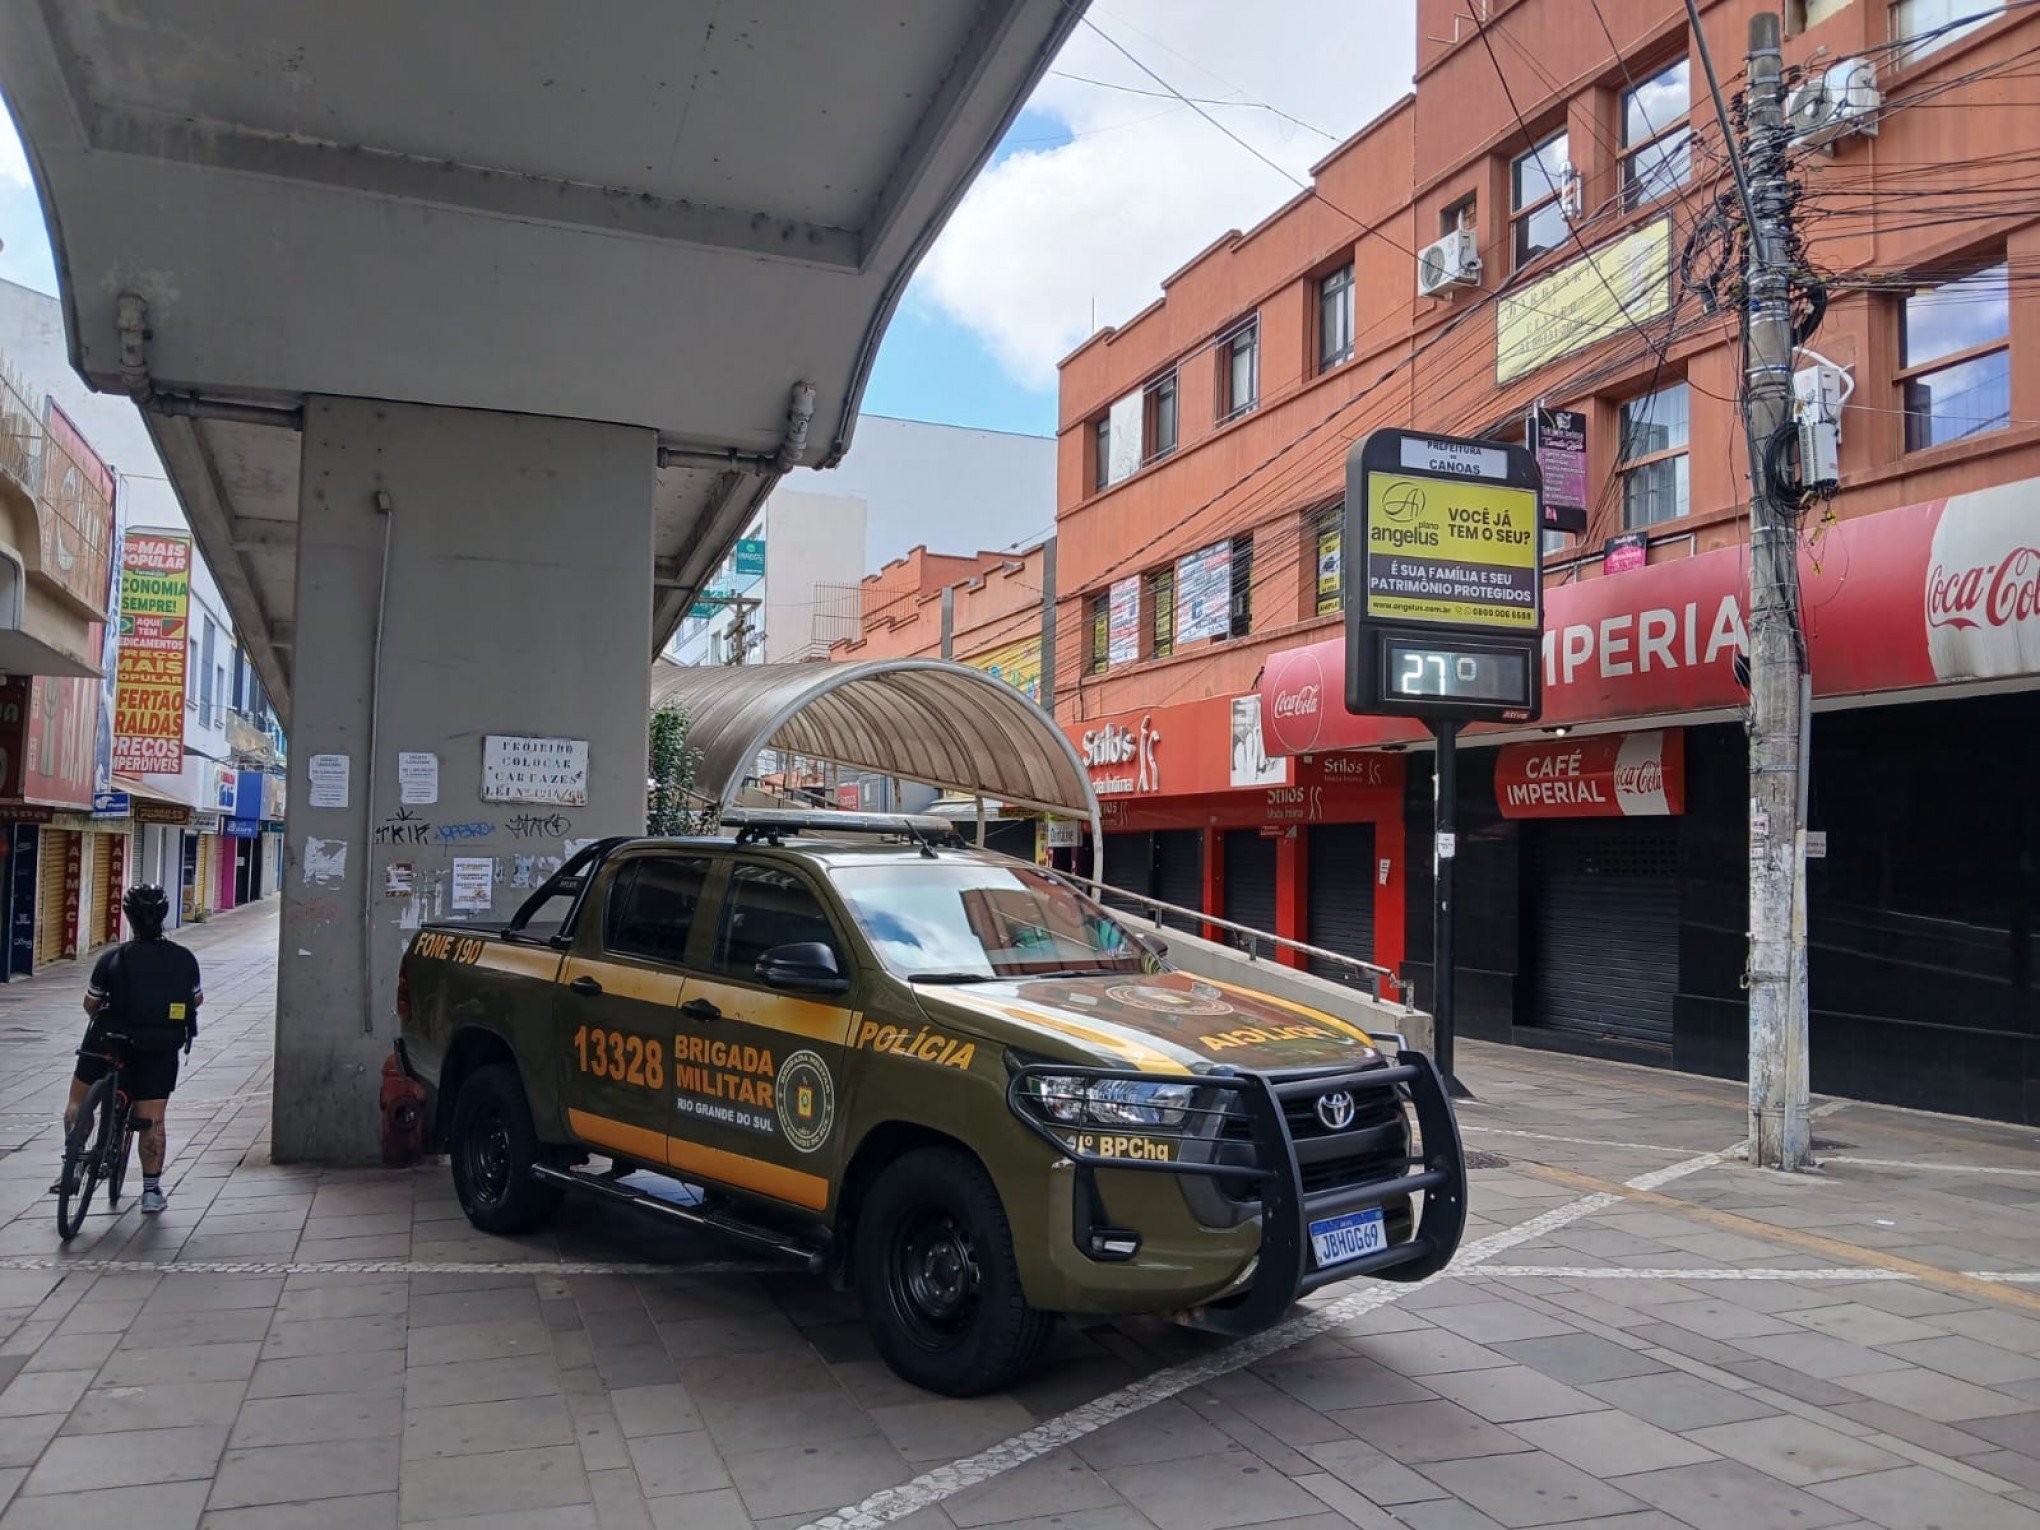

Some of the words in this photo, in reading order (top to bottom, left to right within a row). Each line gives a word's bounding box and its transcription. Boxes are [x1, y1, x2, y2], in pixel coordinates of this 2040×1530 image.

[1427, 440, 1482, 456] PREFEITURA
[1429, 459, 1481, 475] CANOAS
[1448, 507, 1490, 525] VOCÊ
[1493, 509, 1512, 528] JÁ
[1371, 522, 1439, 548] angelus
[1447, 523, 1479, 540] TEM
[1482, 527, 1493, 541] O
[1496, 529, 1531, 545] SEU?
[138, 541, 186, 557] MAIS
[1390, 559, 1398, 575] É
[1400, 564, 1427, 577] SUA
[1428, 565, 1479, 583] FAMÍLIA
[1481, 572, 1488, 583] E
[1489, 572, 1512, 585] SEU
[122, 578, 188, 596] CONOMIA
[1370, 577, 1452, 595] PATRIMÔNIO
[1454, 585, 1531, 602] PROTEGIDOS
[122, 596, 177, 613] SEMPRE!
[136, 617, 160, 627] AQUI
[137, 627, 158, 636] TEM
[119, 637, 185, 650] EDICAMENTOS
[119, 673, 183, 683] OPULAR
[118, 688, 183, 711] FERTÃO
[1274, 684, 1320, 719] Coca-Cola
[114, 710, 182, 736] RALDAS
[502, 757, 571, 769] COLOCAR
[1525, 749, 1582, 779] CAFÉ
[495, 772, 577, 784] CARTAZES
[486, 785, 510, 796] LEI
[1506, 779, 1607, 806] IMPERIAL
[413, 932, 455, 960] FONE
[453, 937, 483, 965] 190
[675, 1034, 774, 1077] BRIGADA
[857, 1020, 975, 1071] POLÍCIA
[573, 1025, 664, 1091] 13328
[676, 1063, 774, 1109] MILITAR
[677, 1097, 693, 1112] RIO
[695, 1102, 734, 1122] GRANDE
[736, 1112, 751, 1126] DO
[752, 1115, 774, 1131] SUL
[1100, 1135, 1169, 1163] BPChq
